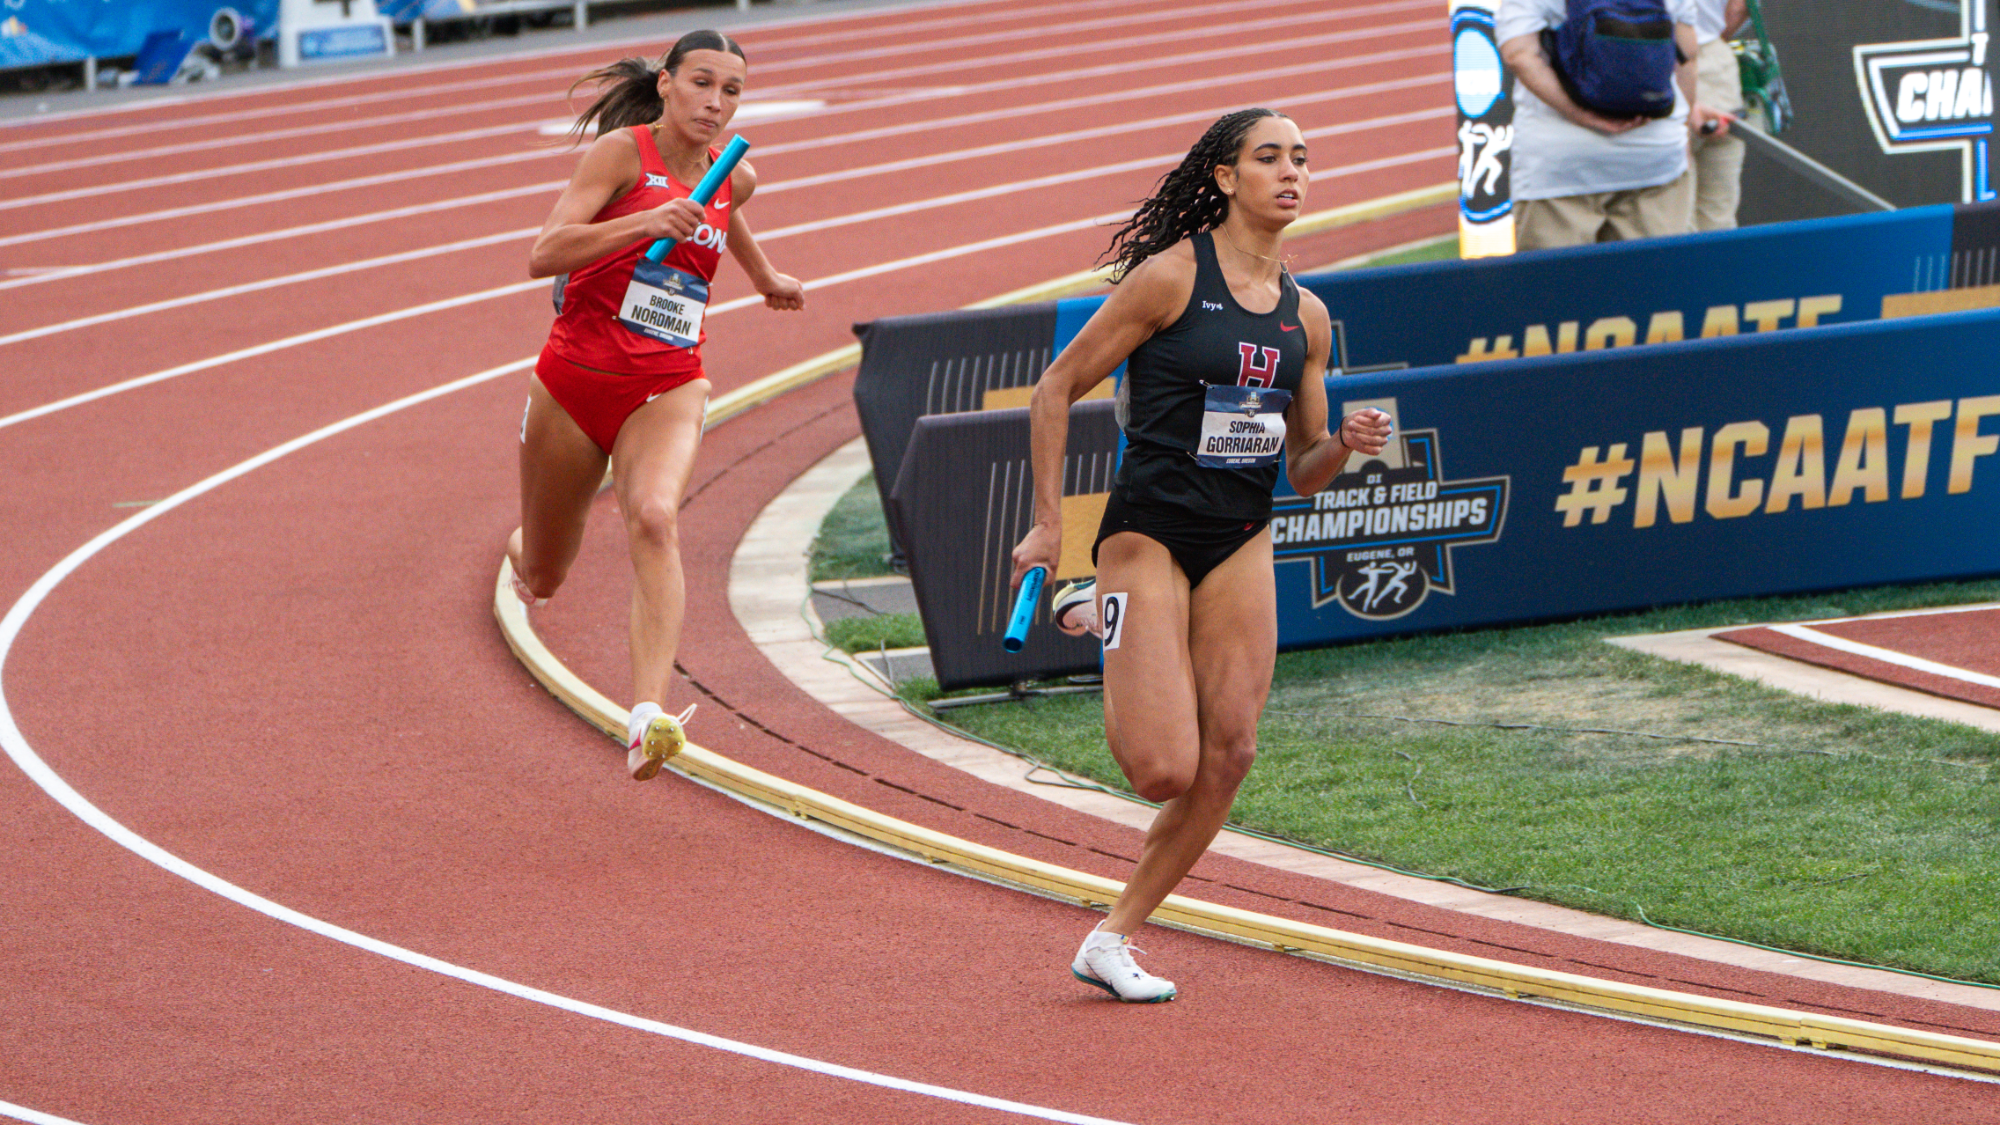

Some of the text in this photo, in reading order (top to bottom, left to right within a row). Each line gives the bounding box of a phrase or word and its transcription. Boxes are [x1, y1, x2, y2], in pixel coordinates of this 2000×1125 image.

[631, 304, 691, 336] NORDMAN
[649, 295, 685, 315] BROOKE
[1236, 342, 1280, 388] H
[1229, 420, 1266, 433] SOPHIA
[1206, 436, 1280, 453] GORRIARAN
[1555, 394, 2000, 528] #NCAATF
[1313, 481, 1438, 510] TRACK & FIELD
[1271, 498, 1488, 544] CHAMPIONSHIPS
[1346, 547, 1415, 562] EUGENE, OR
[1104, 596, 1119, 647] 9
